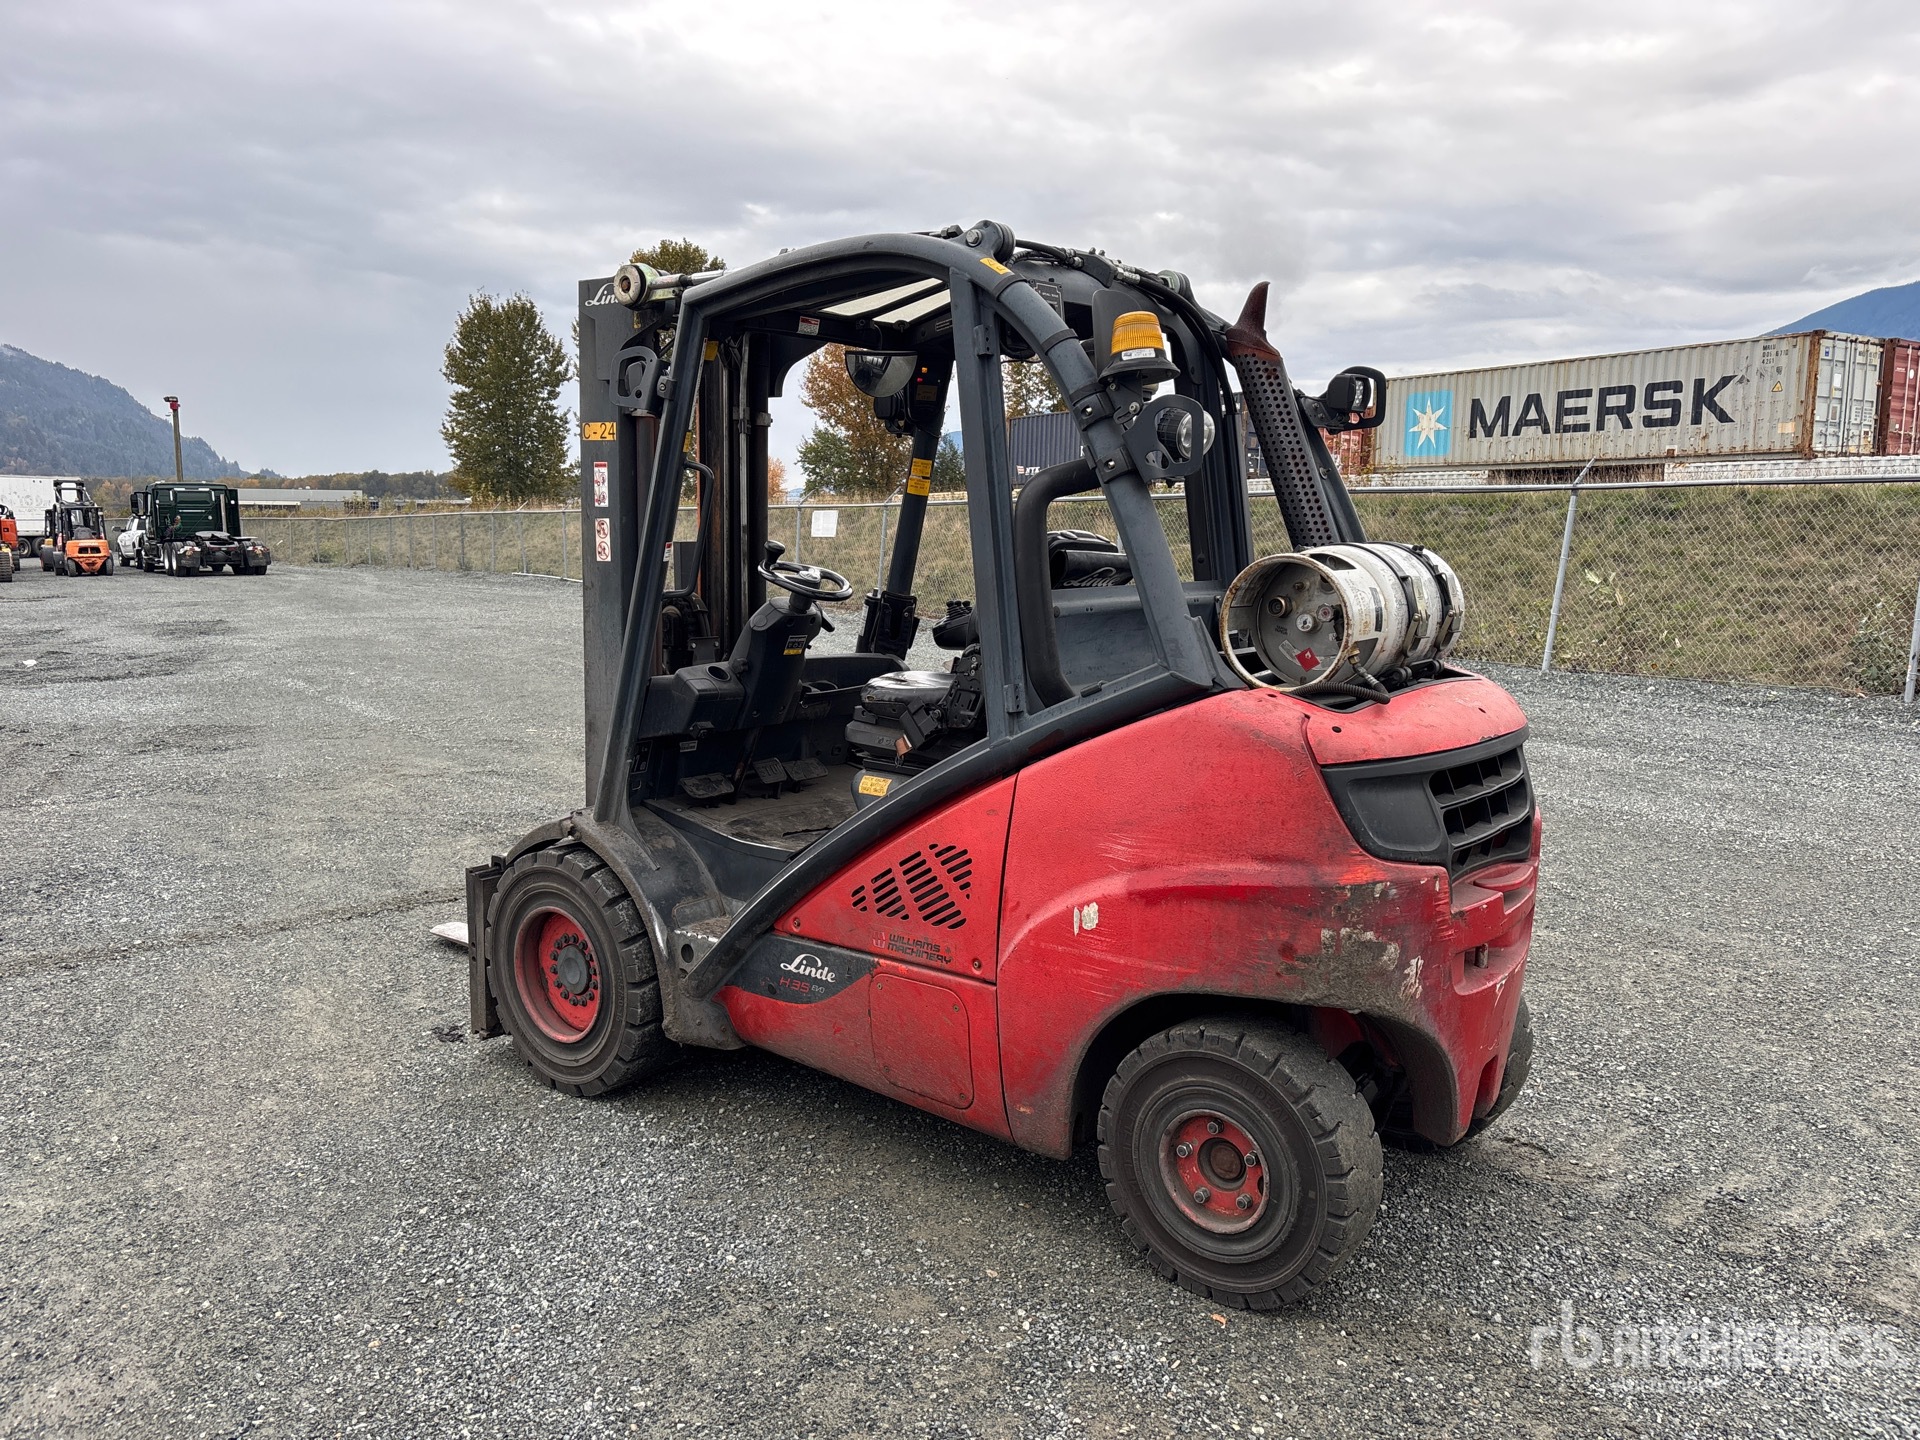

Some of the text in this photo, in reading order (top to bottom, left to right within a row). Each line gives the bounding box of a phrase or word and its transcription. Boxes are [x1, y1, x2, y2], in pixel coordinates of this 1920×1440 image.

[585, 282, 619, 307] Lin
[1469, 374, 1738, 439] MAERSK
[583, 422, 616, 440] C-24
[887, 942, 953, 965] MACHINERY
[889, 934, 941, 953] WILLIAMS
[780, 953, 837, 984] Linde
[811, 984, 826, 994] EVO
